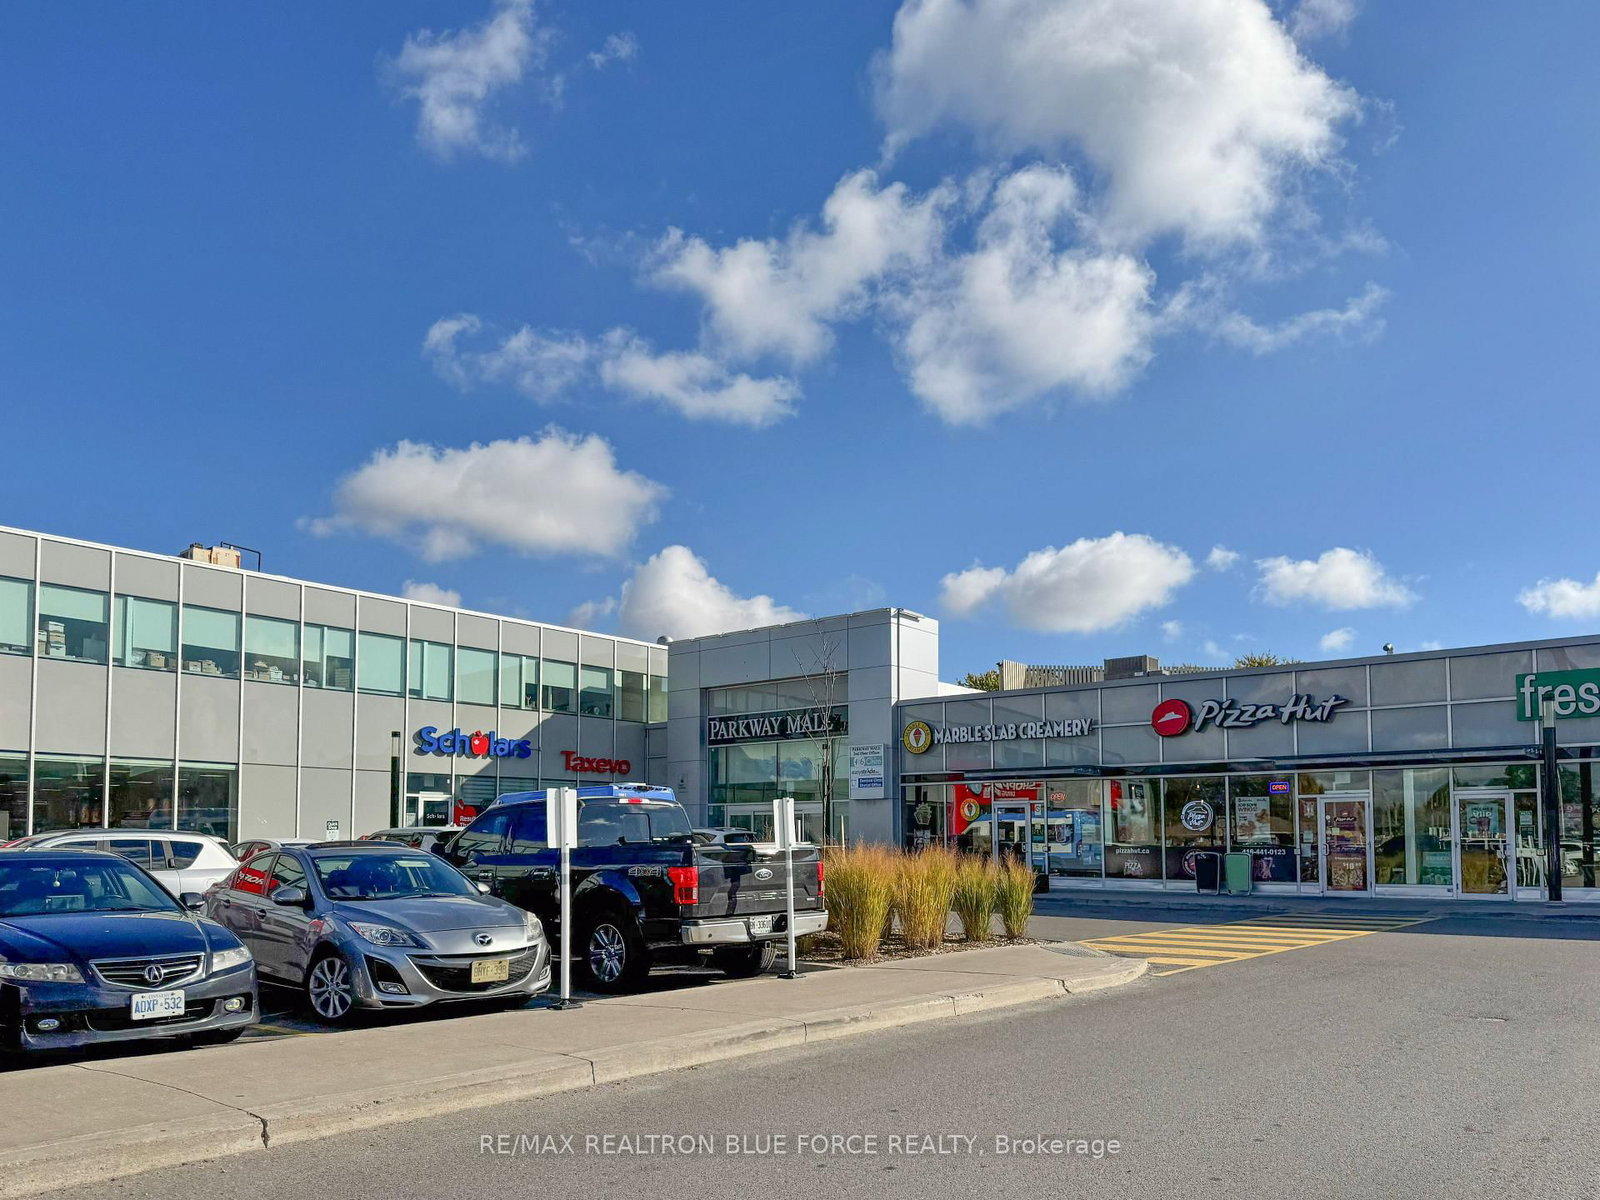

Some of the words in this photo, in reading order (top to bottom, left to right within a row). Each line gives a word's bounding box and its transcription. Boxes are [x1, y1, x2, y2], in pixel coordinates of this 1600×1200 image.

[709, 717, 781, 740] PARKWAY
[786, 712, 834, 734] MALL
[1195, 699, 1277, 733] Pizza
[1280, 694, 1349, 723] Hut
[934, 726, 982, 744] MARBLE
[983, 724, 1016, 742] SLAB
[1019, 718, 1093, 739] CREAMERY
[560, 750, 631, 775] Taxevo
[1050, 792, 1067, 801] OPEN
[134, 1000, 159, 1014] ADXP
[164, 996, 182, 1010] 532
